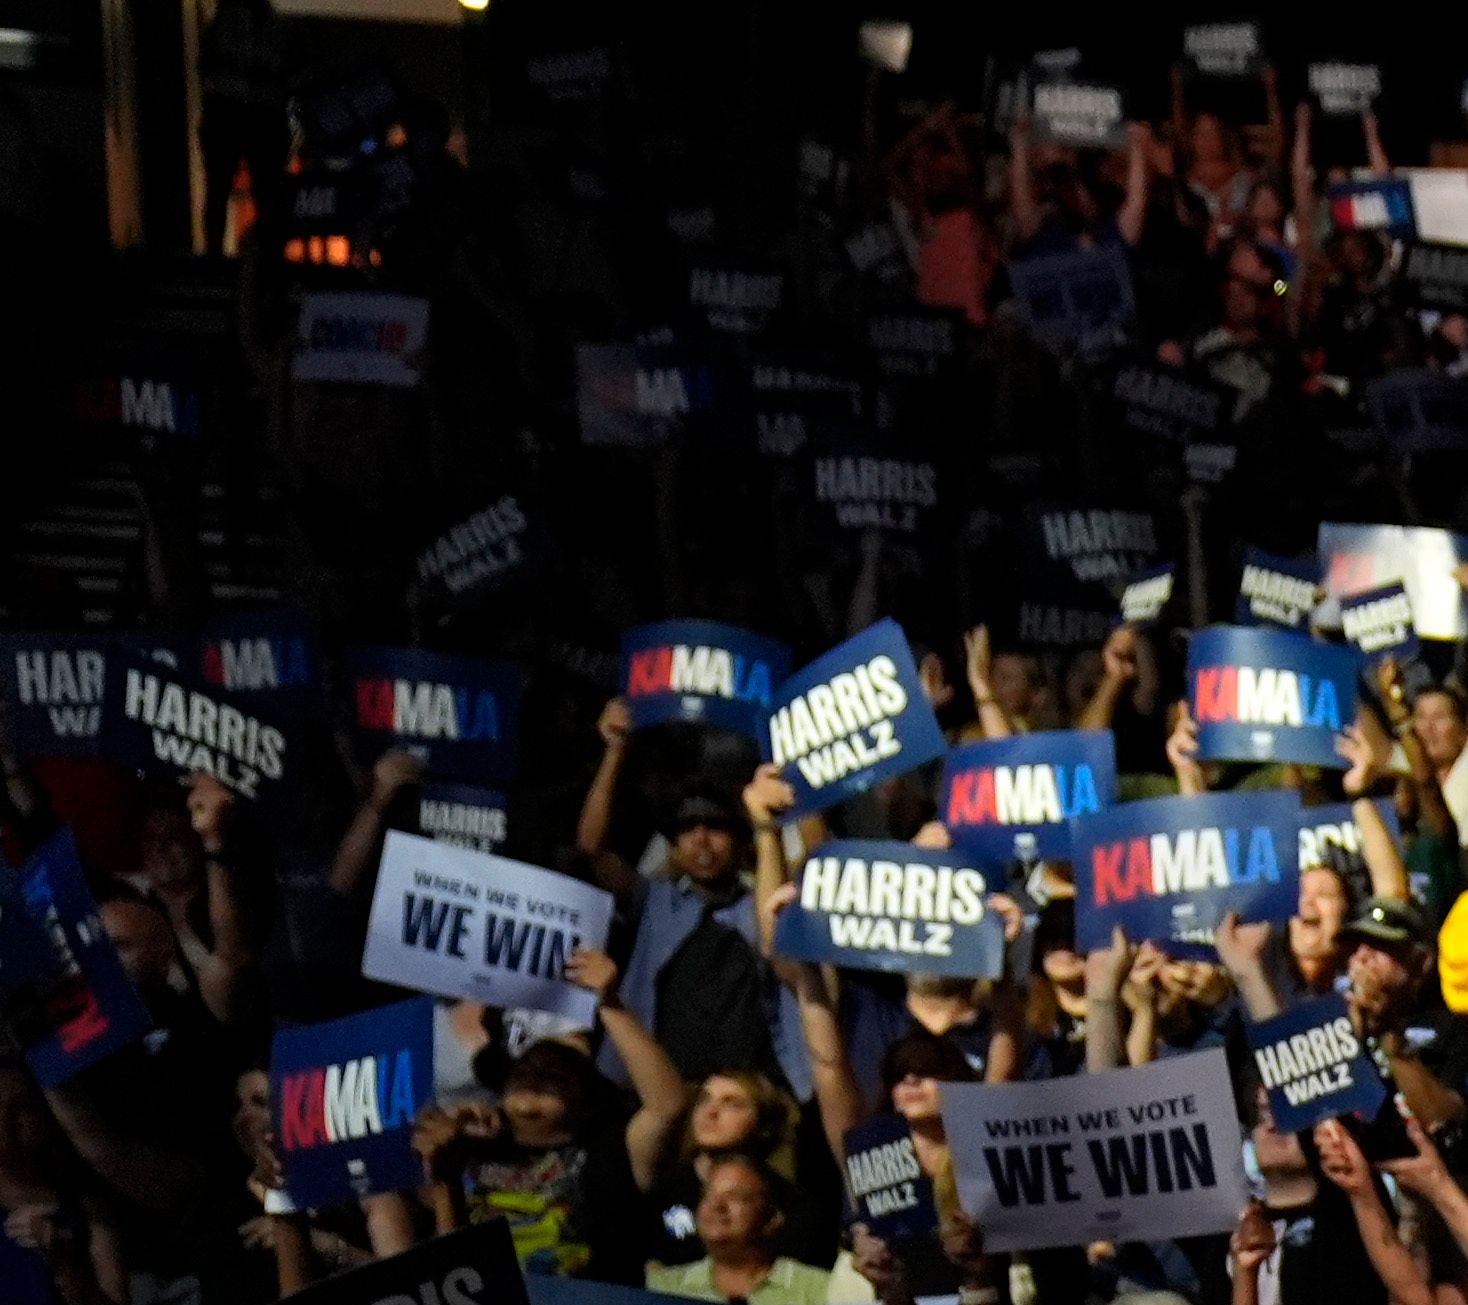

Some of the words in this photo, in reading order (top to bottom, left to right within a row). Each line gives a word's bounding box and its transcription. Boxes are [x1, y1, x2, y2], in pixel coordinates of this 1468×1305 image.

[628, 643, 772, 708] KAMALA
[1195, 666, 1341, 730] KAMALA
[124, 669, 288, 782] HARRIS
[769, 654, 908, 767] HARRIS
[797, 722, 902, 790] WALZ
[948, 763, 1099, 828] KAMALA
[801, 856, 987, 925] HARRIS
[1090, 826, 1281, 907] KAMALA
[400, 892, 470, 963] WE
[483, 917, 580, 982] WIN
[526, 899, 582, 926] VOTE
[828, 915, 953, 956] WALZ
[1254, 1016, 1360, 1090] HARRIS
[984, 1115, 1072, 1140] WHEN
[1077, 1107, 1120, 1132] WE
[1127, 1094, 1197, 1122] VOTE
[1282, 1064, 1353, 1109] WALZ
[846, 1137, 922, 1199] HARRIS
[983, 1144, 1078, 1210] WE
[1089, 1121, 1217, 1201] WIN
[864, 1186, 920, 1216] WALZ
